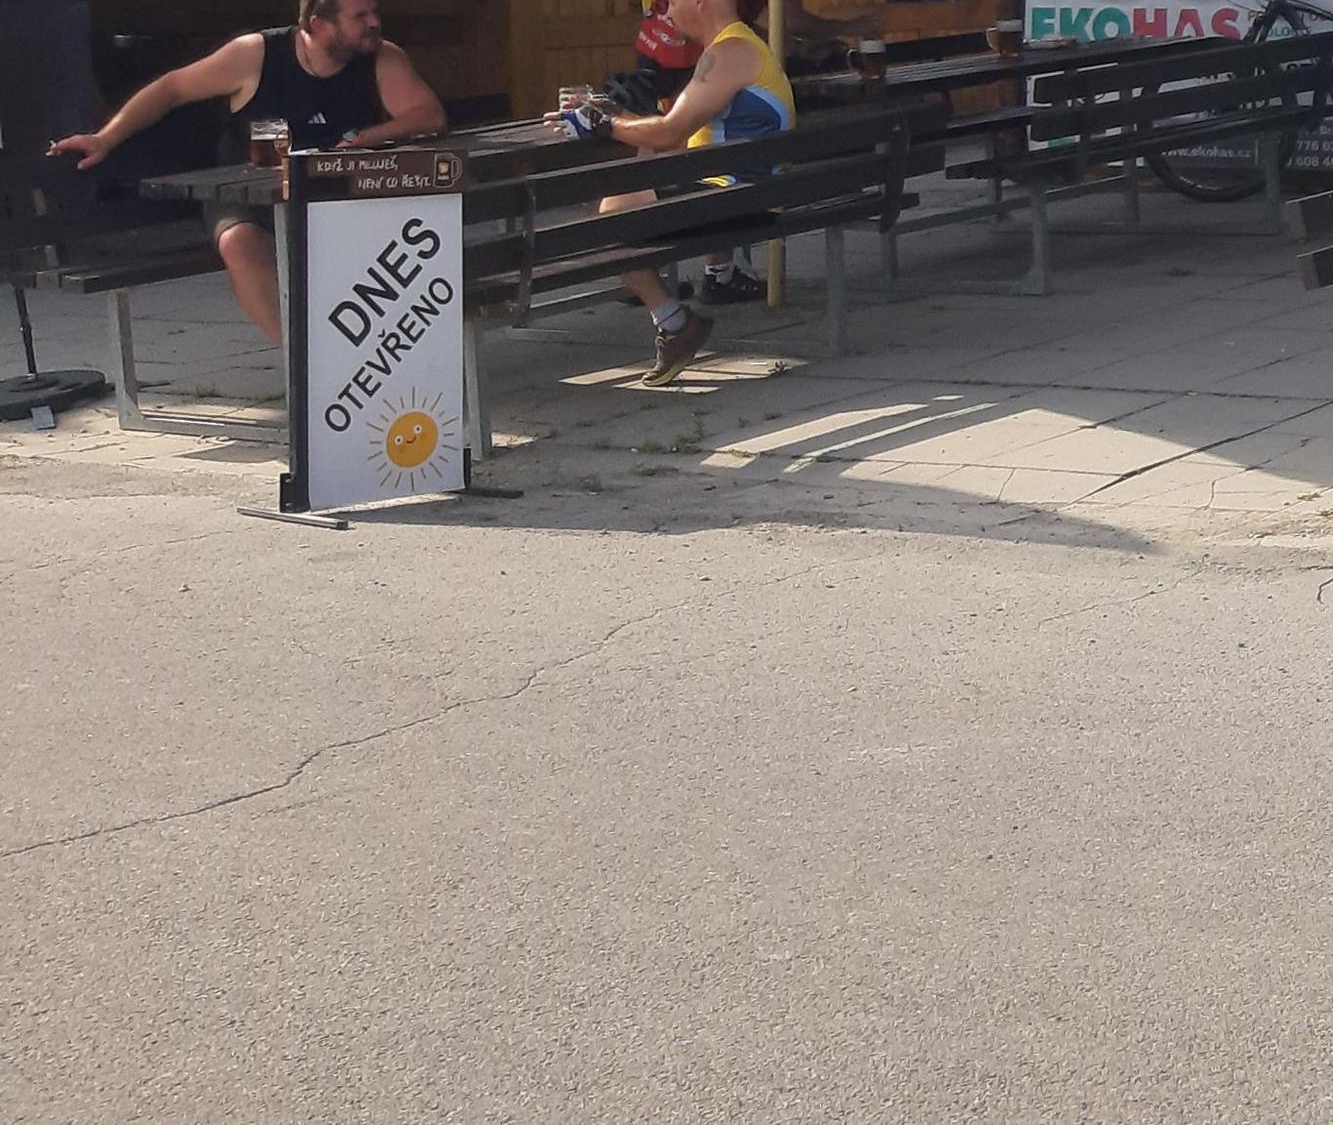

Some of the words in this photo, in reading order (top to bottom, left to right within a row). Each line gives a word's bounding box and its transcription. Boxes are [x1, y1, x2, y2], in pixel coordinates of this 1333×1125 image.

[1031, 6, 1239, 44] EKOHAS
[328, 217, 441, 348] DNES
[324, 276, 454, 433] OTEVŘENO
